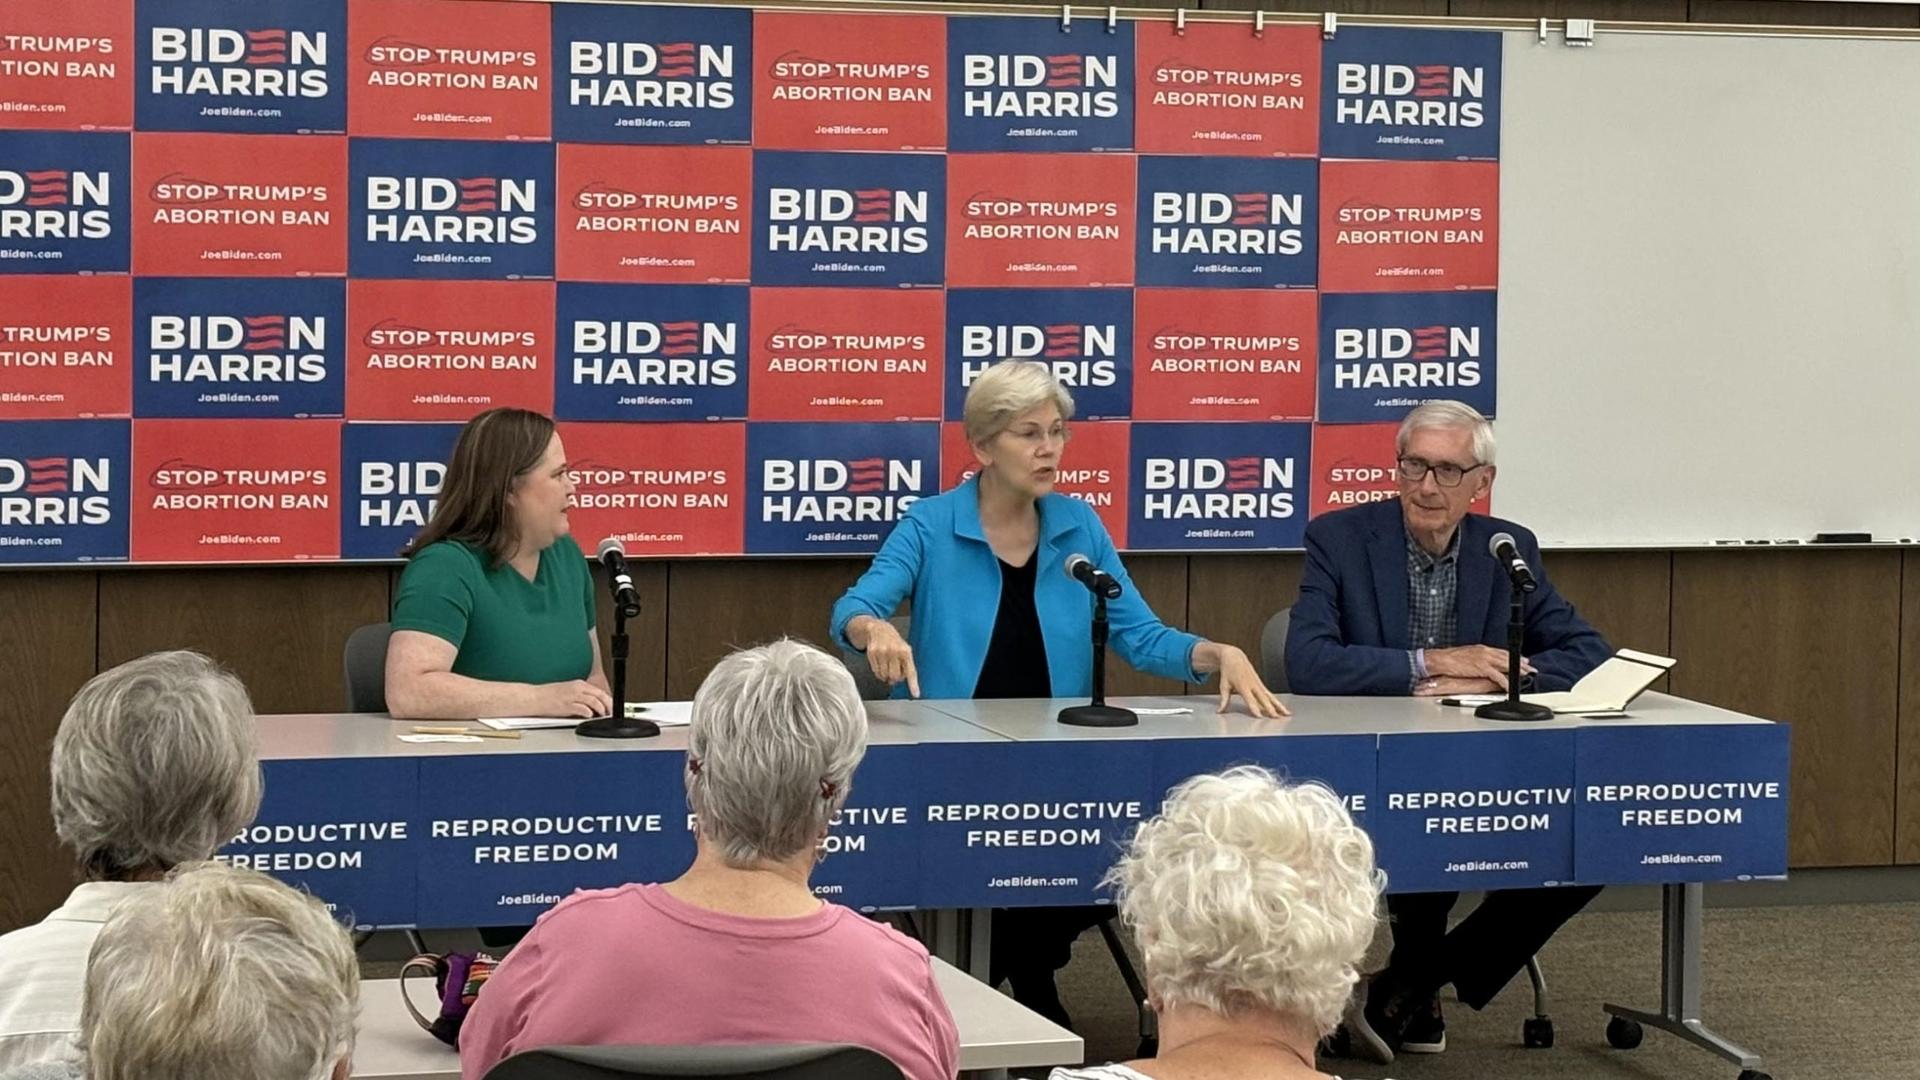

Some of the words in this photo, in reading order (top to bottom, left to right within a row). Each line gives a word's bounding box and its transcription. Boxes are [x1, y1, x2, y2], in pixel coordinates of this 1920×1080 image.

[5, 36, 112, 52] TRUMP'S
[153, 28, 326, 65] BIDEN
[372, 47, 430, 62] STOP
[436, 49, 536, 66] TRUMP'S
[571, 42, 732, 77] BIDEN
[1, 61, 58, 76] TION
[67, 63, 114, 77] BAN
[776, 63, 830, 76] STOP
[836, 64, 929, 78] TRUMP'S
[965, 55, 1116, 87] BIDEN
[153, 67, 328, 97] HARRIS
[368, 71, 485, 88] ABORTION
[493, 75, 537, 89] BAN
[1157, 69, 1208, 83] STOP
[1214, 71, 1302, 86] TRUMP'S
[1338, 64, 1483, 97] BIDEN
[571, 79, 734, 108] HARRIS
[773, 86, 881, 100] ABORTION
[889, 88, 931, 101] BAN
[1154, 92, 1256, 107] ABORTION
[1263, 96, 1303, 109] BAN
[0, 101, 66, 113] Biden.com
[199, 106, 282, 117] JoeBiden.com
[965, 92, 1118, 117] HARRIS
[413, 112, 493, 124] JoeBiden.com
[1337, 99, 1483, 127] HARRIS
[614, 117, 691, 128] JoeBiden.com
[815, 125, 889, 135] JoeBiden.com
[1006, 127, 1078, 137] JoeBiden.com
[1191, 131, 1262, 141] JoeBiden.com
[1376, 135, 1445, 145] JoeBiden.com
[0, 171, 109, 205] DEN
[157, 184, 218, 199] STOP
[224, 186, 326, 200] TRUMP'S
[368, 177, 535, 212] BIDEN
[580, 193, 636, 207] STOP
[641, 195, 737, 209] TRUMP'S
[770, 189, 927, 222] BIDEN
[1154, 193, 1302, 224] BIDEN
[968, 202, 1022, 215] STOP
[1027, 203, 1116, 216] TRUMP'S
[1340, 209, 1390, 221] STOP
[1395, 208, 1481, 221] TRUMP'S
[2, 210, 110, 238] RRIS
[154, 209, 274, 224] ABORTION
[283, 211, 329, 225] BAN
[368, 215, 536, 243] HARRIS
[577, 217, 688, 232] ABORTION
[696, 219, 739, 233] BAN
[965, 225, 1071, 238] ABORTION
[1078, 226, 1118, 239] BAN
[770, 225, 928, 253] HARRIS
[1153, 228, 1302, 254] HARRIS
[1337, 231, 1438, 243] ABORTION
[1444, 230, 1483, 242] BAN
[0, 249, 63, 259] Biden.com
[200, 249, 282, 260] JoeBiden.com
[413, 253, 492, 263] JoeBiden.com
[619, 256, 696, 266] JoeBiden.com
[811, 262, 886, 272] JoeBiden.com
[1006, 263, 1078, 272] JoeBiden.com
[1192, 264, 1262, 273] JoeBiden.com
[1375, 267, 1444, 276] JoeBiden.com
[4, 327, 110, 341] TRUMP'S
[151, 316, 324, 349] BIDEN
[372, 331, 430, 344] STOP
[436, 332, 534, 346] TRUMP'S
[574, 321, 735, 354] BIDEN
[772, 335, 827, 348] STOP
[832, 336, 924, 349] TRUMP'S
[962, 325, 1116, 357] BIDEN
[1154, 337, 1206, 349] STOP
[1211, 337, 1299, 350] TRUMP'S
[1336, 327, 1480, 359] BIDEN
[0, 352, 56, 366] TION
[65, 352, 112, 365] BAN
[368, 355, 484, 369] ABORTION
[492, 356, 536, 369] BAN
[768, 359, 877, 371] ABORTION
[884, 359, 926, 372] BAN
[1151, 359, 1254, 372] ABORTION
[1261, 360, 1300, 372] BAN
[151, 355, 326, 381] HARRIS
[574, 358, 736, 385] HARRIS
[962, 360, 1116, 386] HRIS
[1336, 361, 1480, 388] HARRIS
[0, 392, 65, 402] Biden.com
[197, 393, 280, 402] JoeBiden.com
[412, 394, 491, 404] JoeBiden.com
[617, 395, 693, 405] JoeBiden.com
[809, 396, 884, 406] JoeBiden.com
[1189, 396, 1260, 405] JoeBiden.com
[0, 459, 109, 492] DEN
[157, 471, 217, 484] STOP
[224, 471, 326, 484] TRUMP'S
[361, 462, 447, 495] BID
[568, 471, 625, 485] STOP
[630, 471, 726, 484] TRUMP'S
[764, 460, 921, 491] BIDEN
[1054, 470, 1110, 484] MP'S
[1146, 458, 1293, 489] BIDEN
[1331, 469, 1383, 482] STOP
[153, 495, 273, 508] ABORTION
[282, 495, 328, 508] BAN
[684, 494, 728, 508] BAN
[1327, 490, 1400, 504] ABORT
[2, 497, 110, 524] RRIS
[1145, 493, 1293, 518] HARRIS
[0, 536, 63, 546] Biden.com
[198, 534, 281, 544] JoeBiden.com
[805, 532, 879, 541] JoeBiden.com
[1184, 529, 1255, 538] JoeBiden.com
[1389, 787, 1577, 810] REPRODUCTIV
[1587, 783, 1778, 801] REPRODUCTIVE
[928, 801, 1142, 822] REPRODUCTIVE
[1623, 808, 1741, 825] FREEDOM
[433, 815, 661, 837] REPRODUCTIVE
[1426, 814, 1549, 833] FREEDOM
[230, 821, 407, 844] RODUCTIVE
[968, 829, 1100, 846] FREEDOM
[476, 843, 617, 863] FREEDOM
[1640, 853, 1722, 865] JoeBiden.com
[1444, 860, 1529, 872] JoeBiden.com
[987, 876, 1078, 888] JoeBiden.com
[497, 893, 561, 906] JoeBiden
